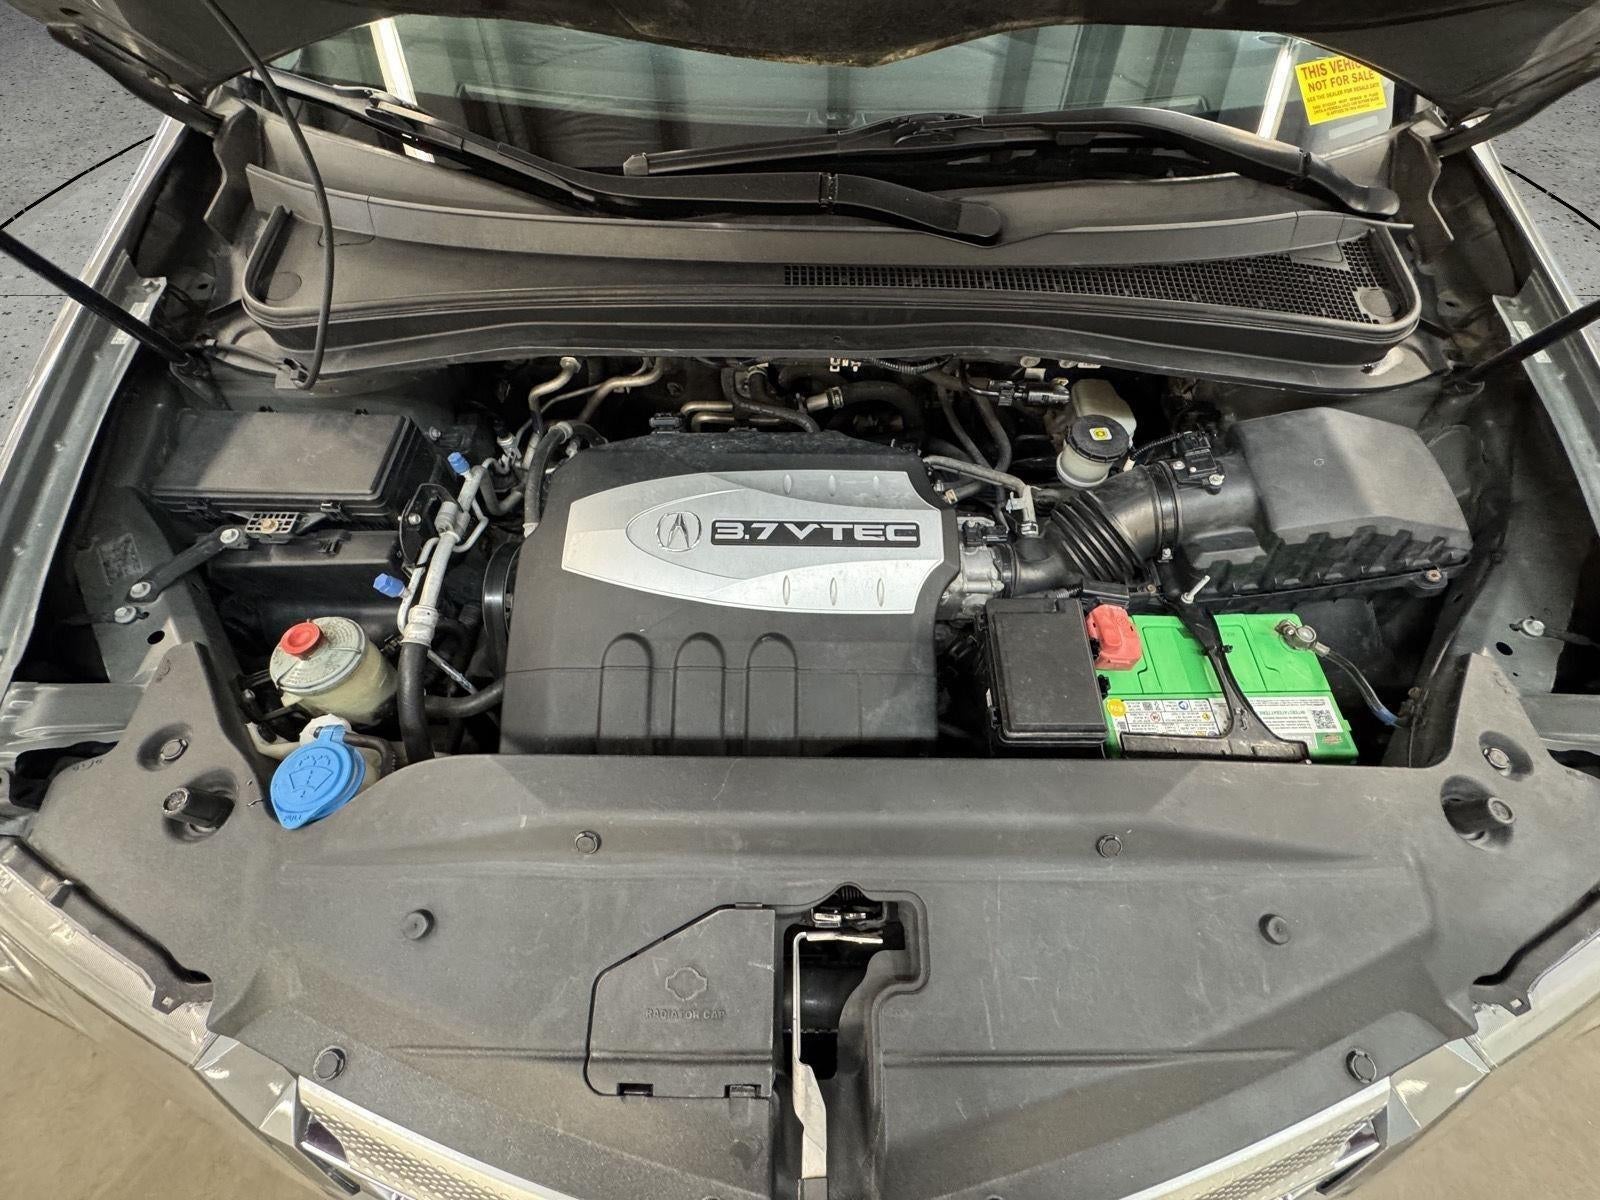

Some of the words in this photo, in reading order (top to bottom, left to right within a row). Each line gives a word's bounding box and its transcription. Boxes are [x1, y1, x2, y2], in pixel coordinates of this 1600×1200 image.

[1301, 62, 1328, 80] THIS
[1329, 58, 1362, 74] VEHIC
[1308, 79, 1328, 93] NOT
[1330, 74, 1350, 88] FOR
[1351, 70, 1375, 83] SALE
[783, 522, 918, 542] VTEC
[645, 1007, 700, 1020] RADIATOR
[703, 1007, 728, 1020] CAP
